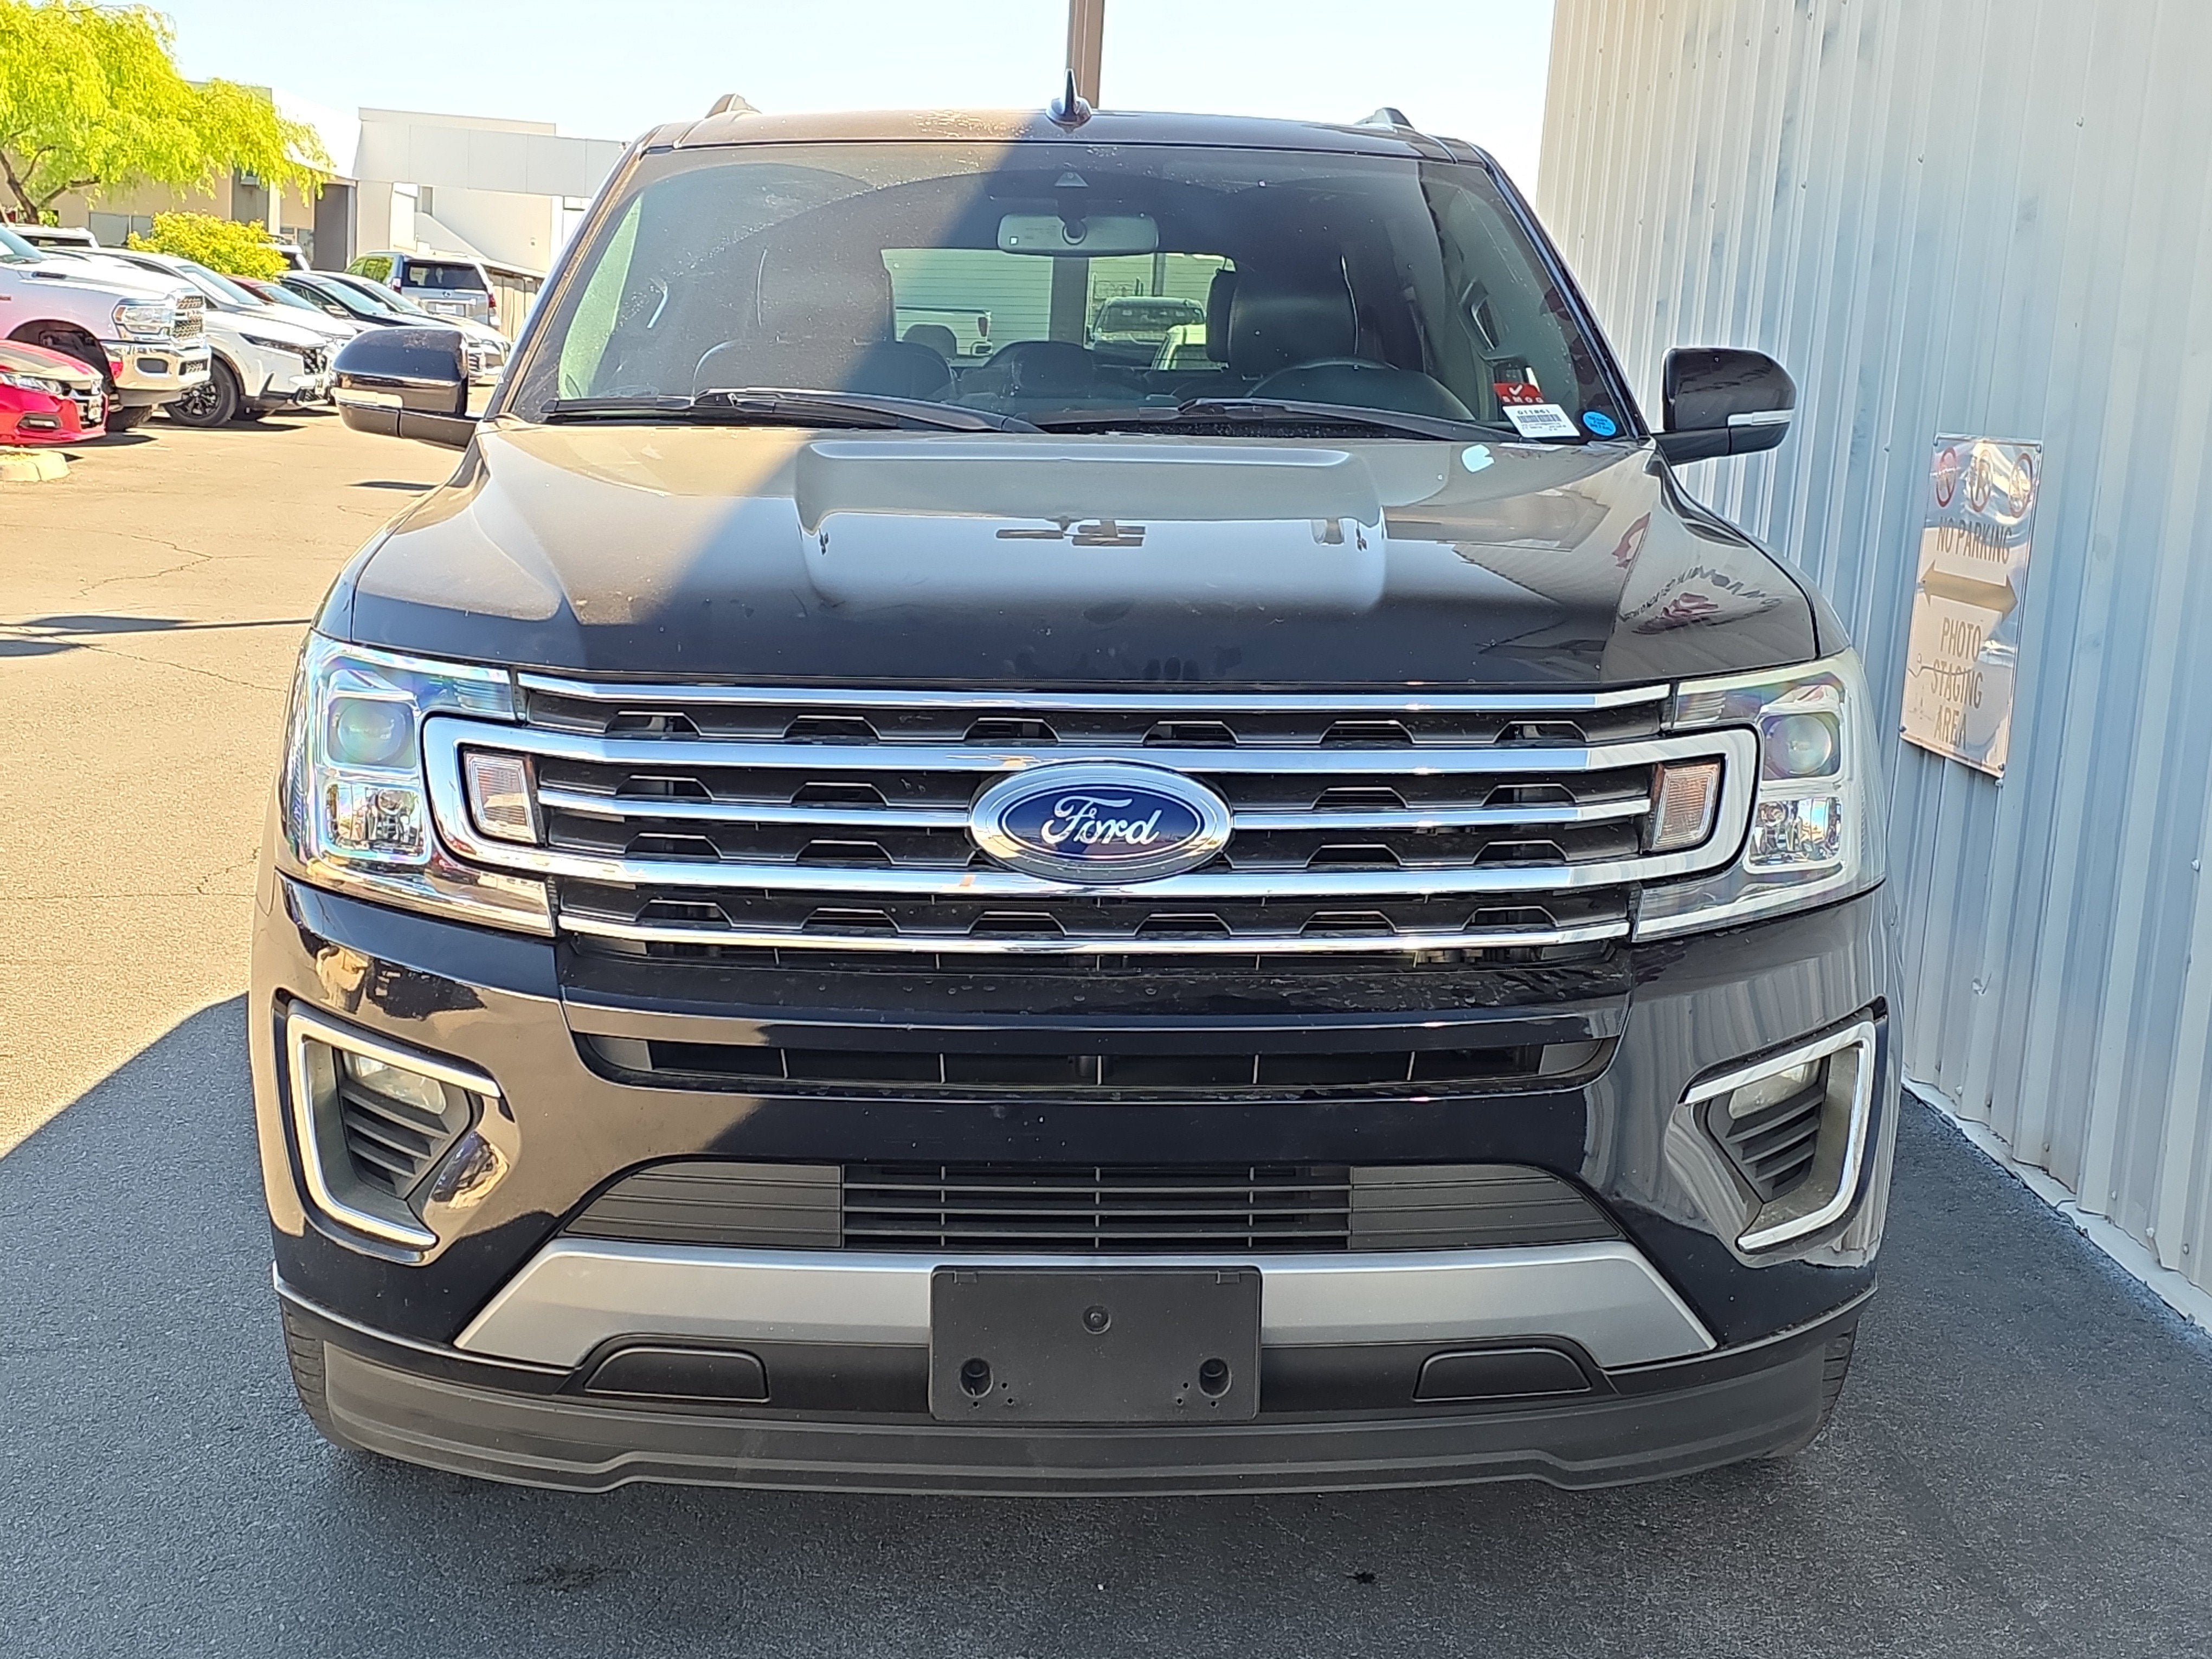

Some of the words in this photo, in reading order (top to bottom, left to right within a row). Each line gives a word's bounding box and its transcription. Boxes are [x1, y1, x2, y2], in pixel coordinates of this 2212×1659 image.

[1936, 516, 1954, 554] NO
[1955, 519, 2012, 564] PARKING
[1940, 616, 1982, 663] PHOTO
[1931, 658, 1983, 709] STAGING
[1933, 705, 1966, 750] AREA
[1040, 795, 1162, 845] Ford
